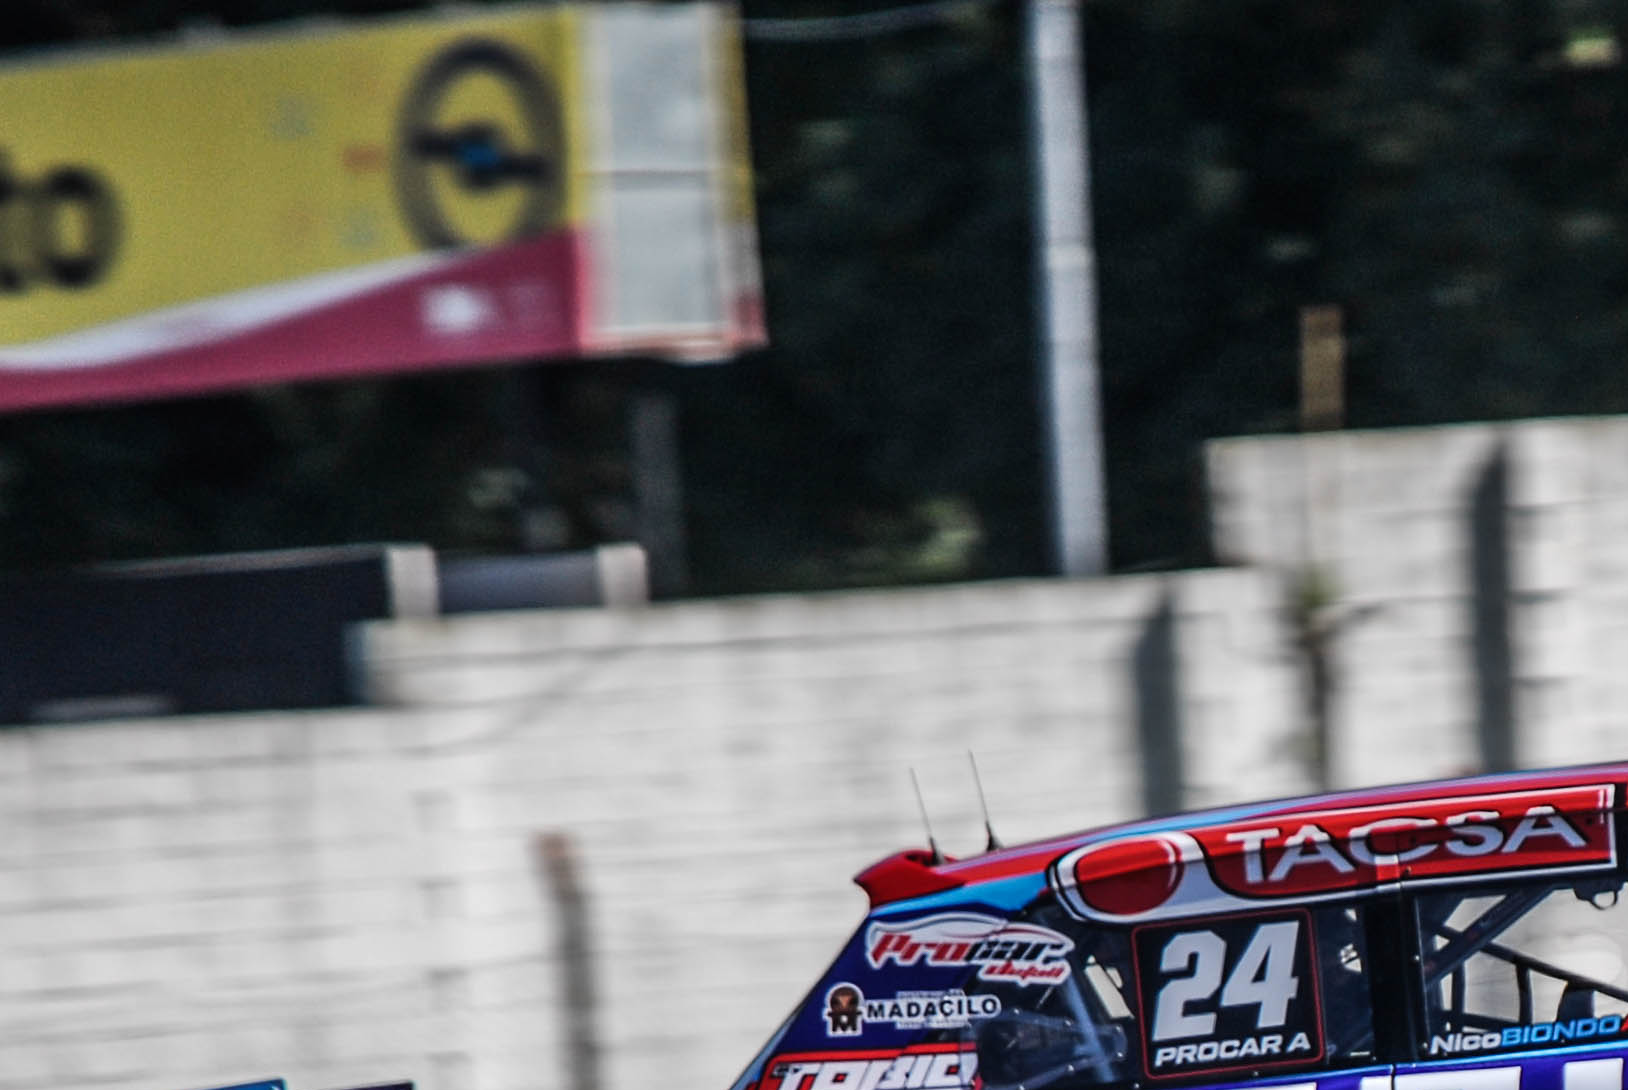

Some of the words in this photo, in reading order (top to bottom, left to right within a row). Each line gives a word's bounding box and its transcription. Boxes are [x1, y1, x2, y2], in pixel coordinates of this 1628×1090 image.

[1226, 806, 1587, 883] TACSA
[1152, 920, 1299, 1042] 24
[867, 999, 998, 1020] MADACILO
[1154, 1034, 1283, 1067] PROCAR
[1286, 1032, 1311, 1051] A
